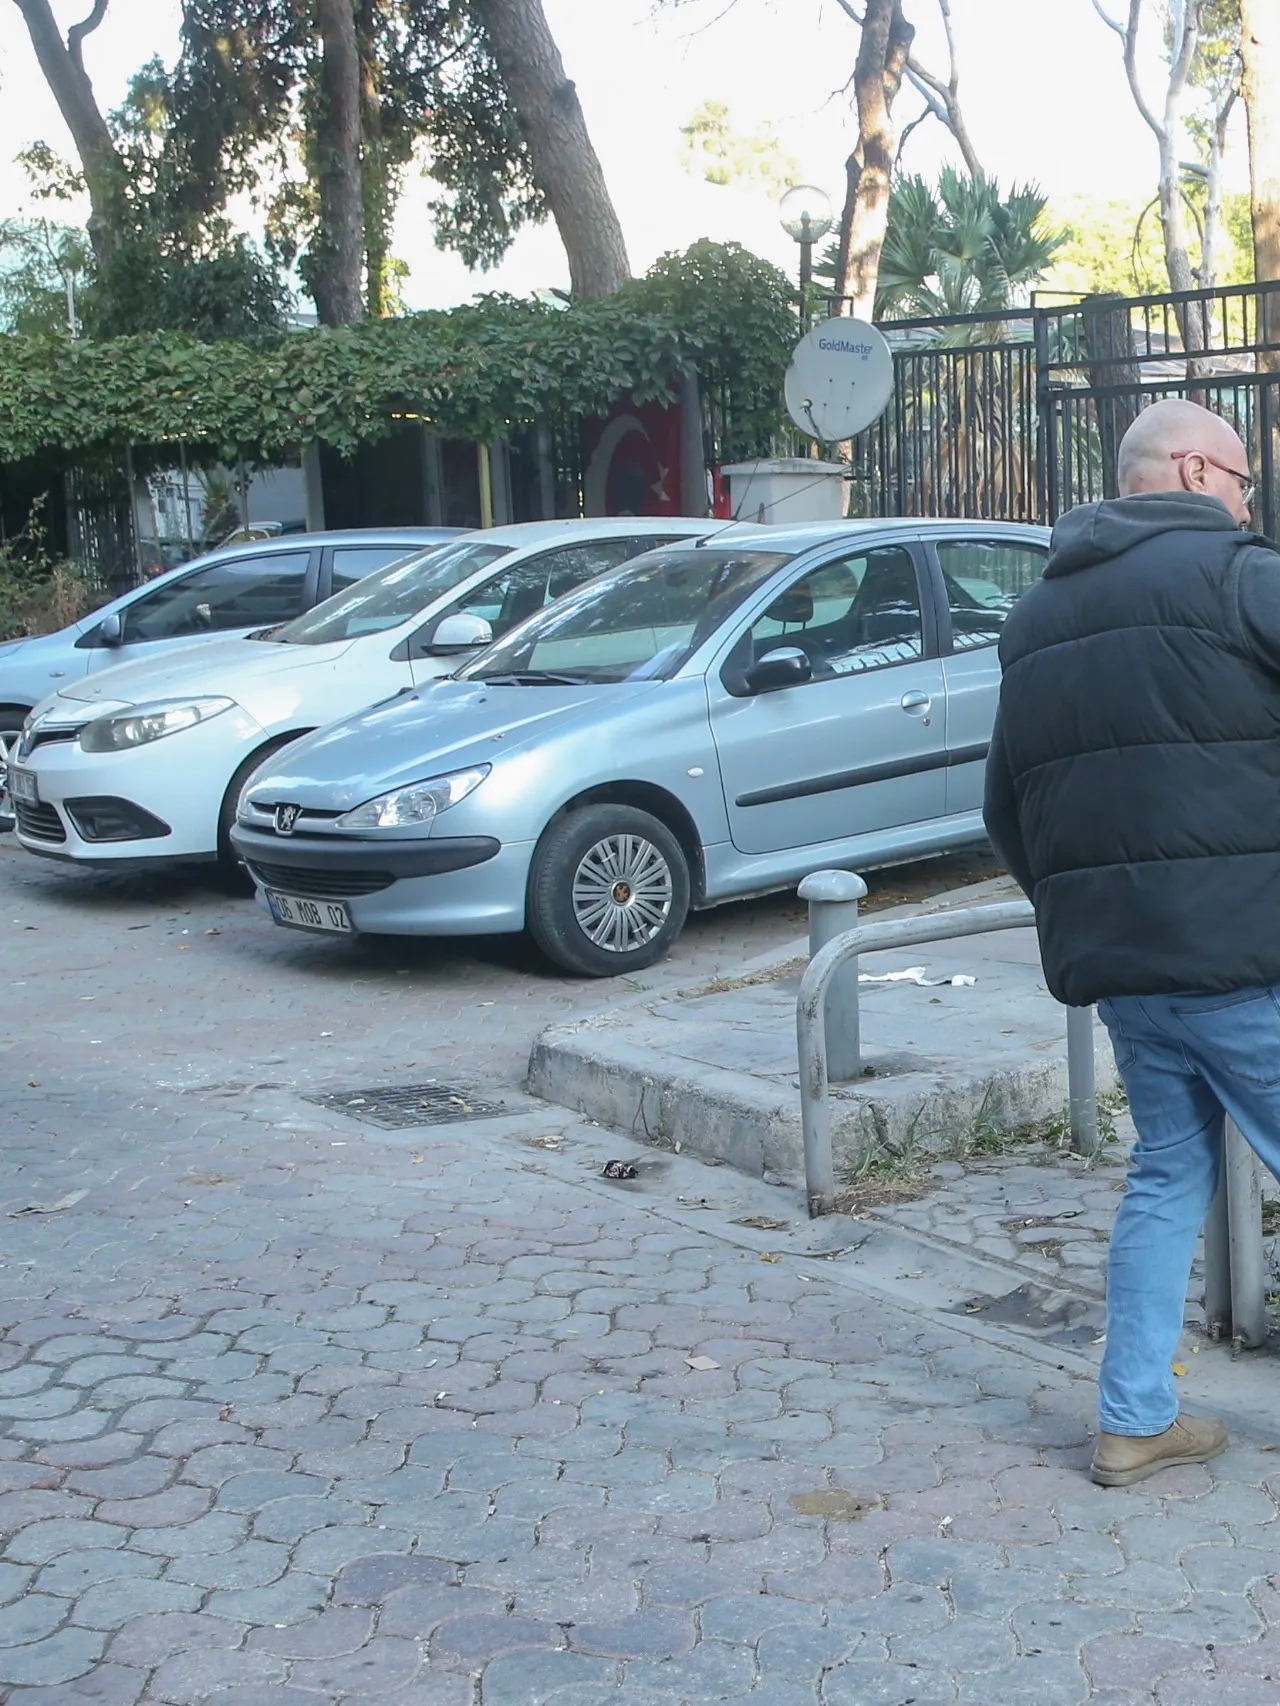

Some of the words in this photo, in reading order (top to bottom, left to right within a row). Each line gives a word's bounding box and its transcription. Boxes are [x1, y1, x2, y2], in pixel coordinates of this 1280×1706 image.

[818, 337, 874, 356] GoldMaster
[295, 899, 322, 925] MOB
[327, 904, 349, 929] 02
